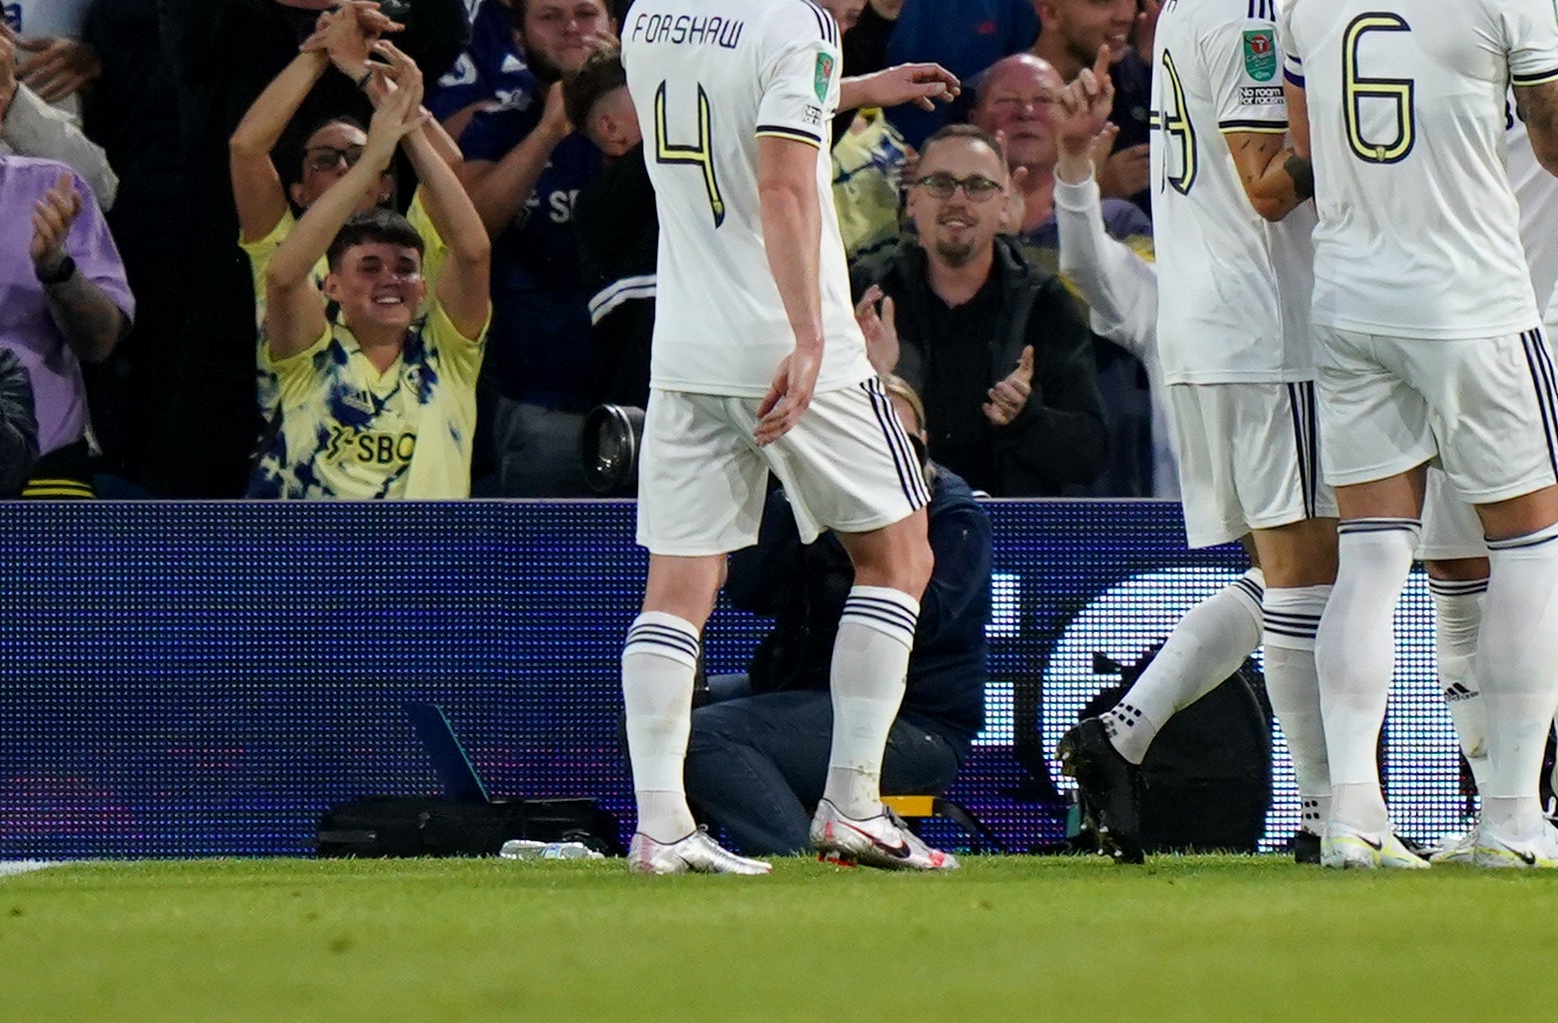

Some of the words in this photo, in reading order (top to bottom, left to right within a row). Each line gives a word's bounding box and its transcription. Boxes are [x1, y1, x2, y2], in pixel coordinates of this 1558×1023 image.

[632, 13, 744, 49] FORSHAW
[1342, 12, 1416, 164] 6
[654, 79, 726, 229] 4
